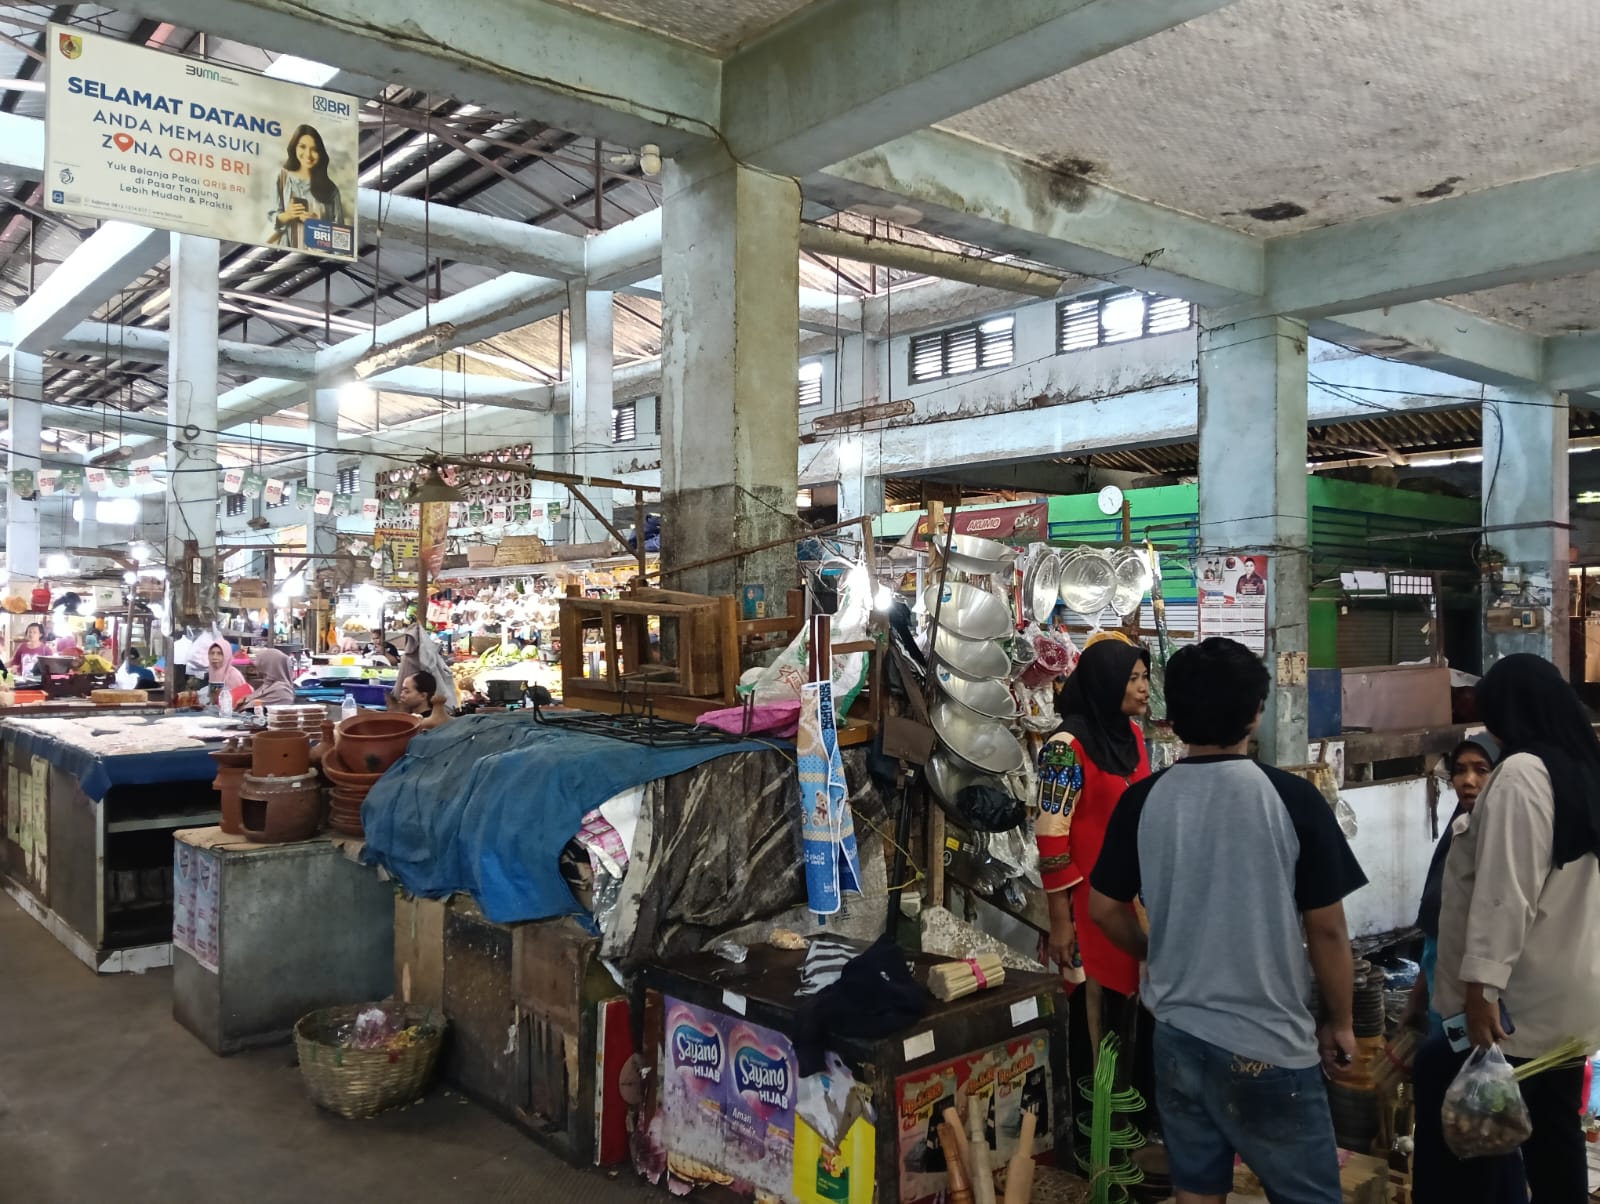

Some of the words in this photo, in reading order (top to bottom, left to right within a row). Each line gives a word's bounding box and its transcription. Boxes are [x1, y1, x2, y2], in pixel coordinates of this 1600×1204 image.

[68, 76, 183, 115] SELAMAT
[190, 103, 282, 137] DATANG
[328, 101, 350, 116] BRI
[93, 110, 152, 133] ANDA
[159, 123, 260, 155] MEMASUKI
[169, 148, 214, 169] QRIS
[221, 158, 250, 176] BRI
[107, 160, 127, 173] Yuk
[130, 164, 169, 180] Belanja
[172, 173, 200, 185] Pakai
[203, 179, 227, 191] QRIS
[230, 184, 246, 194] BRI
[135, 177, 145, 185] di
[147, 178, 176, 191] Pasar
[179, 184, 219, 200] Tanjung
[120, 183, 149, 196] Lebih
[151, 189, 186, 203] Mudah
[188, 196, 196, 204] &
[199, 198, 233, 211] Praktis
[313, 230, 331, 242] BRI
[676, 1031, 718, 1066] Sayang
[694, 1065, 720, 1083] HIJAB
[739, 1054, 785, 1092] Sayang
[759, 1090, 788, 1110] HIJAB
